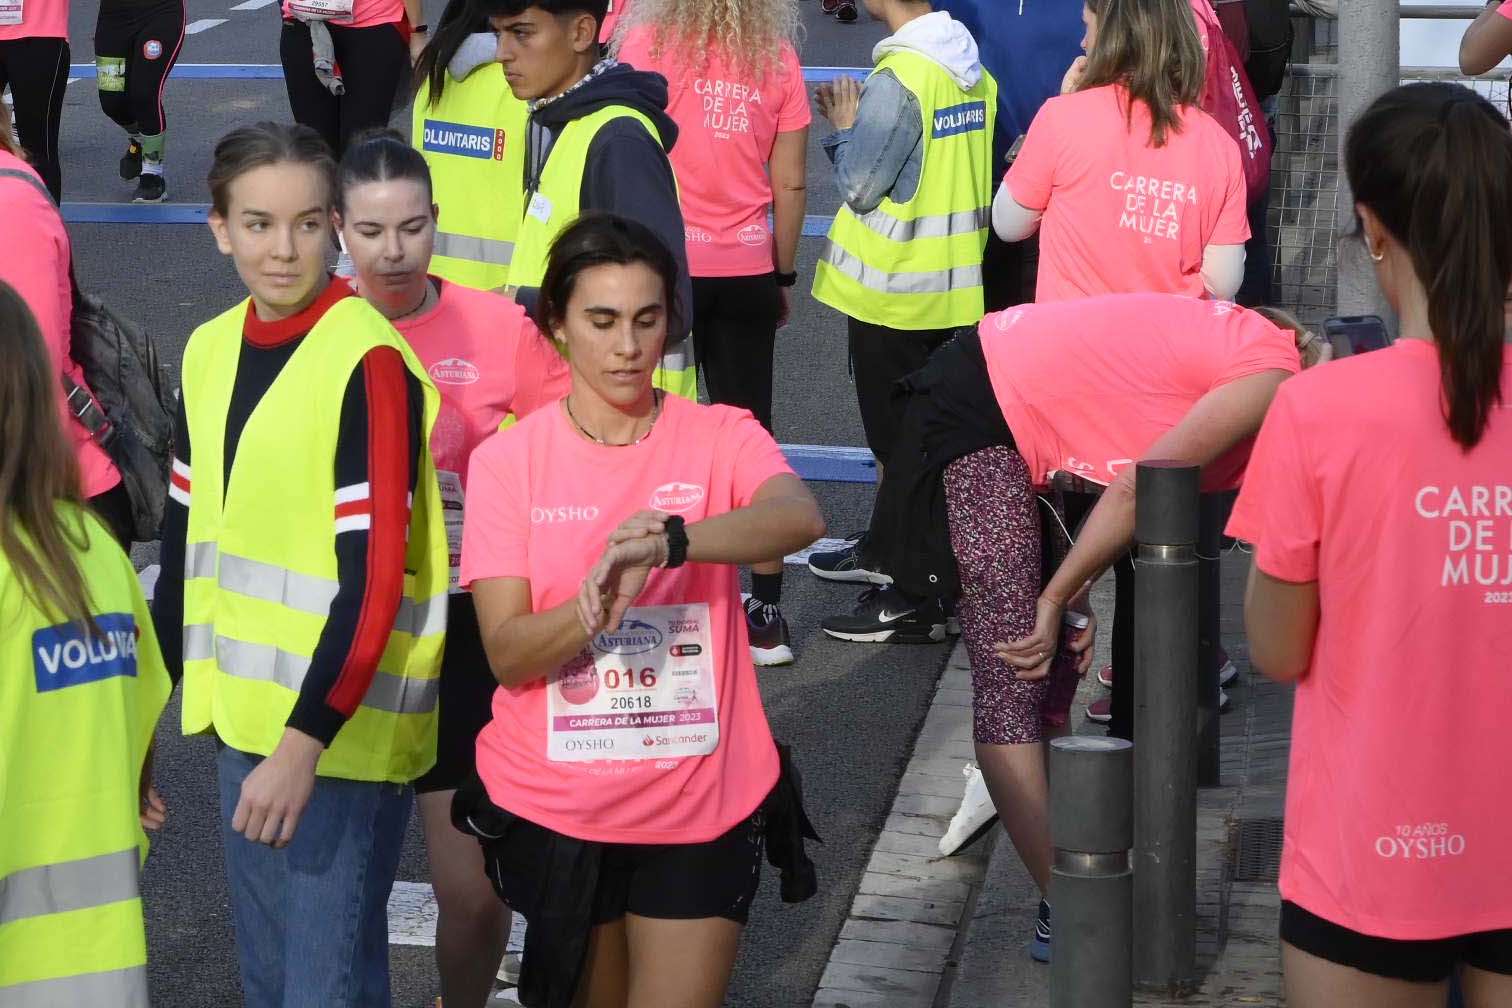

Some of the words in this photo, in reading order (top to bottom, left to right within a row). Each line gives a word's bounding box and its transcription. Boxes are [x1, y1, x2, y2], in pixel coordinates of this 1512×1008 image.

[703, 95, 724, 113] DE
[1110, 171, 1198, 205] CARRERA
[1153, 199, 1178, 220] LA
[1119, 211, 1180, 240] MUER
[531, 505, 600, 523] OYSHO
[1449, 520, 1495, 551] DE
[668, 624, 700, 634] SUMA
[598, 633, 658, 647] ASTURIANA
[603, 667, 658, 690] 016
[610, 695, 652, 710] 20618
[569, 717, 613, 728] CARRERA
[614, 717, 628, 726] DE
[630, 716, 642, 725] LA
[643, 714, 676, 724] MUJER
[679, 712, 702, 722] 2023
[565, 738, 615, 752] OYSHO
[1395, 825, 1411, 838] 10
[1413, 822, 1448, 837] AÑOS
[1374, 833, 1466, 859] OYSHO
